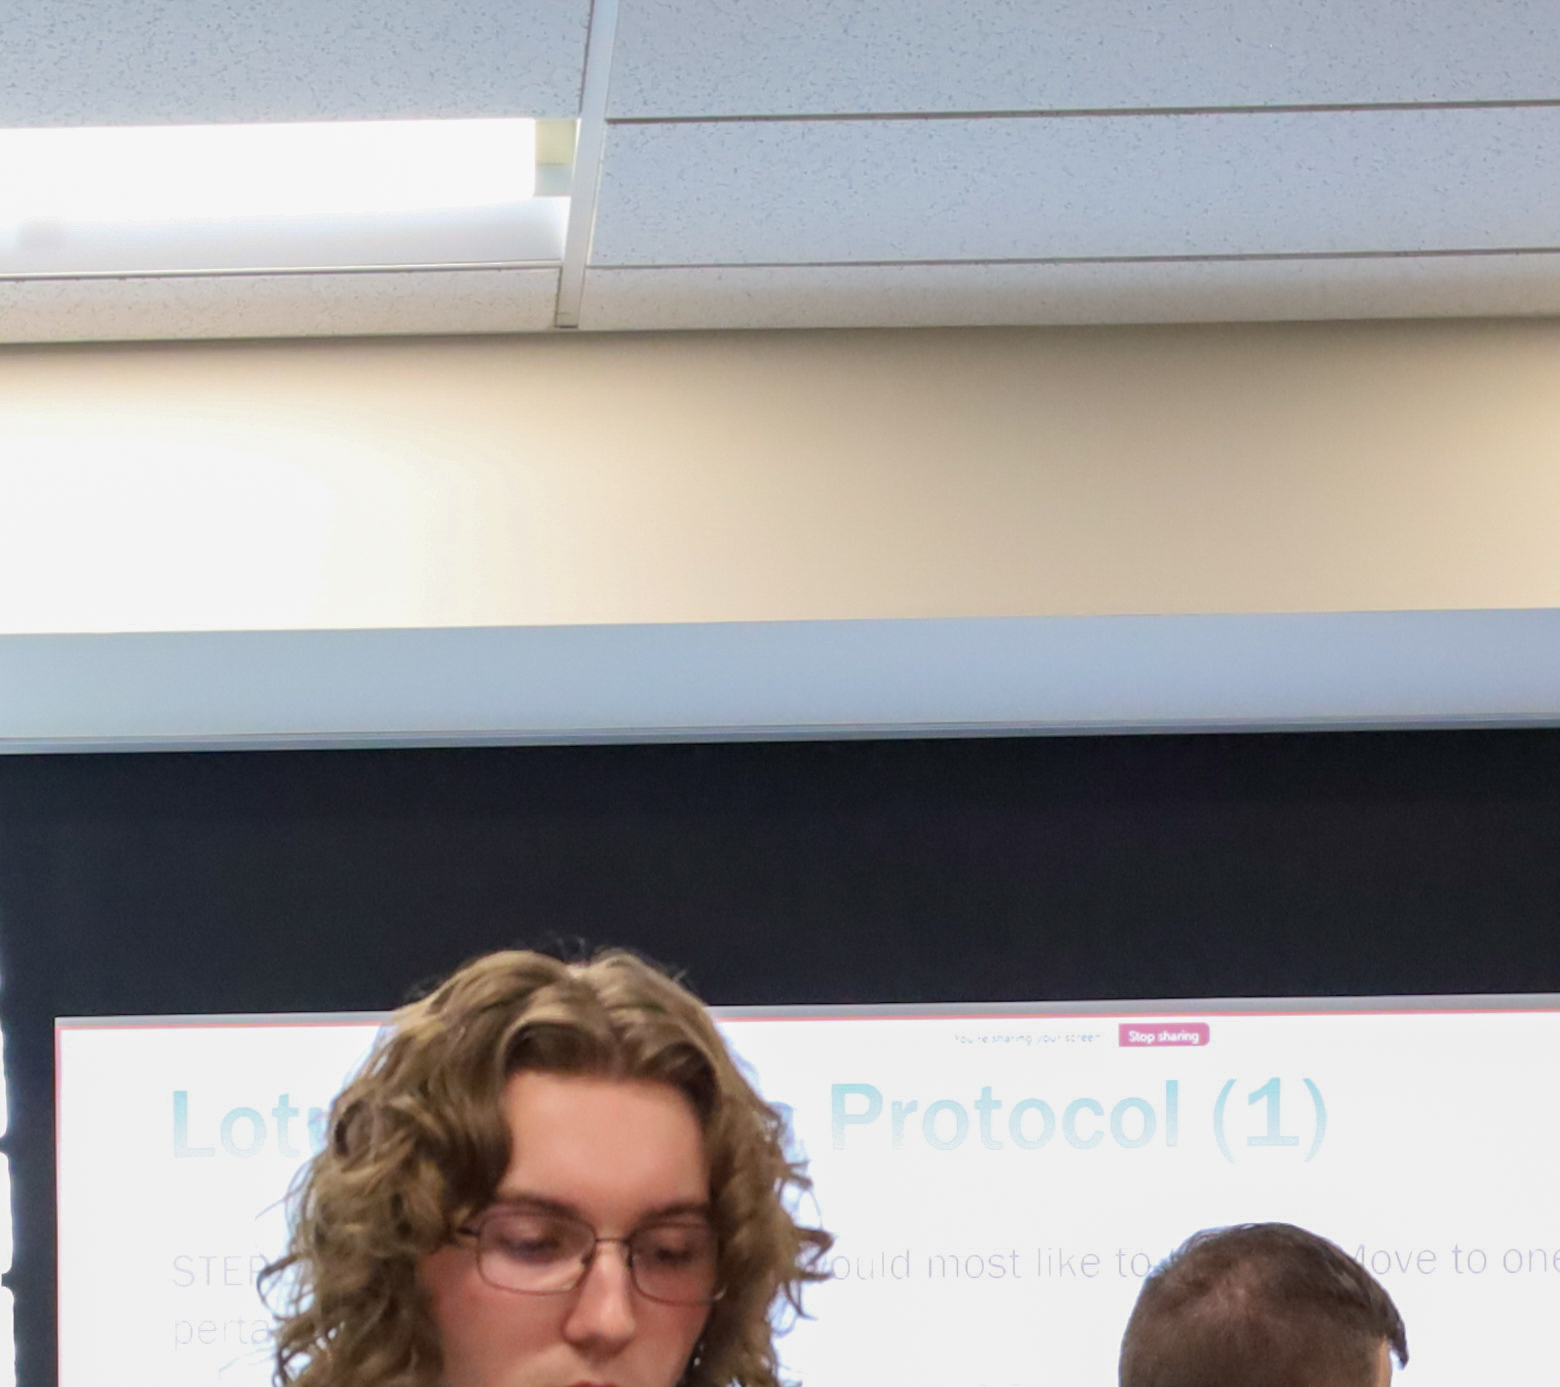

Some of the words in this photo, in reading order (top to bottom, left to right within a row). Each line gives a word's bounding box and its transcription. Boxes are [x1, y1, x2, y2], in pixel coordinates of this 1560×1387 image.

[1128, 1029, 1156, 1045] Stop
[1158, 1028, 1200, 1046] sharing
[831, 1078, 1180, 1152] Protocol
[1212, 1076, 1327, 1165] (1)
[830, 1248, 911, 1281] ould
[927, 1249, 1021, 1281] most
[1036, 1247, 1101, 1280] like
[1115, 1246, 1151, 1279] to
[1451, 1242, 1487, 1275] to
[173, 1314, 271, 1352] perta
